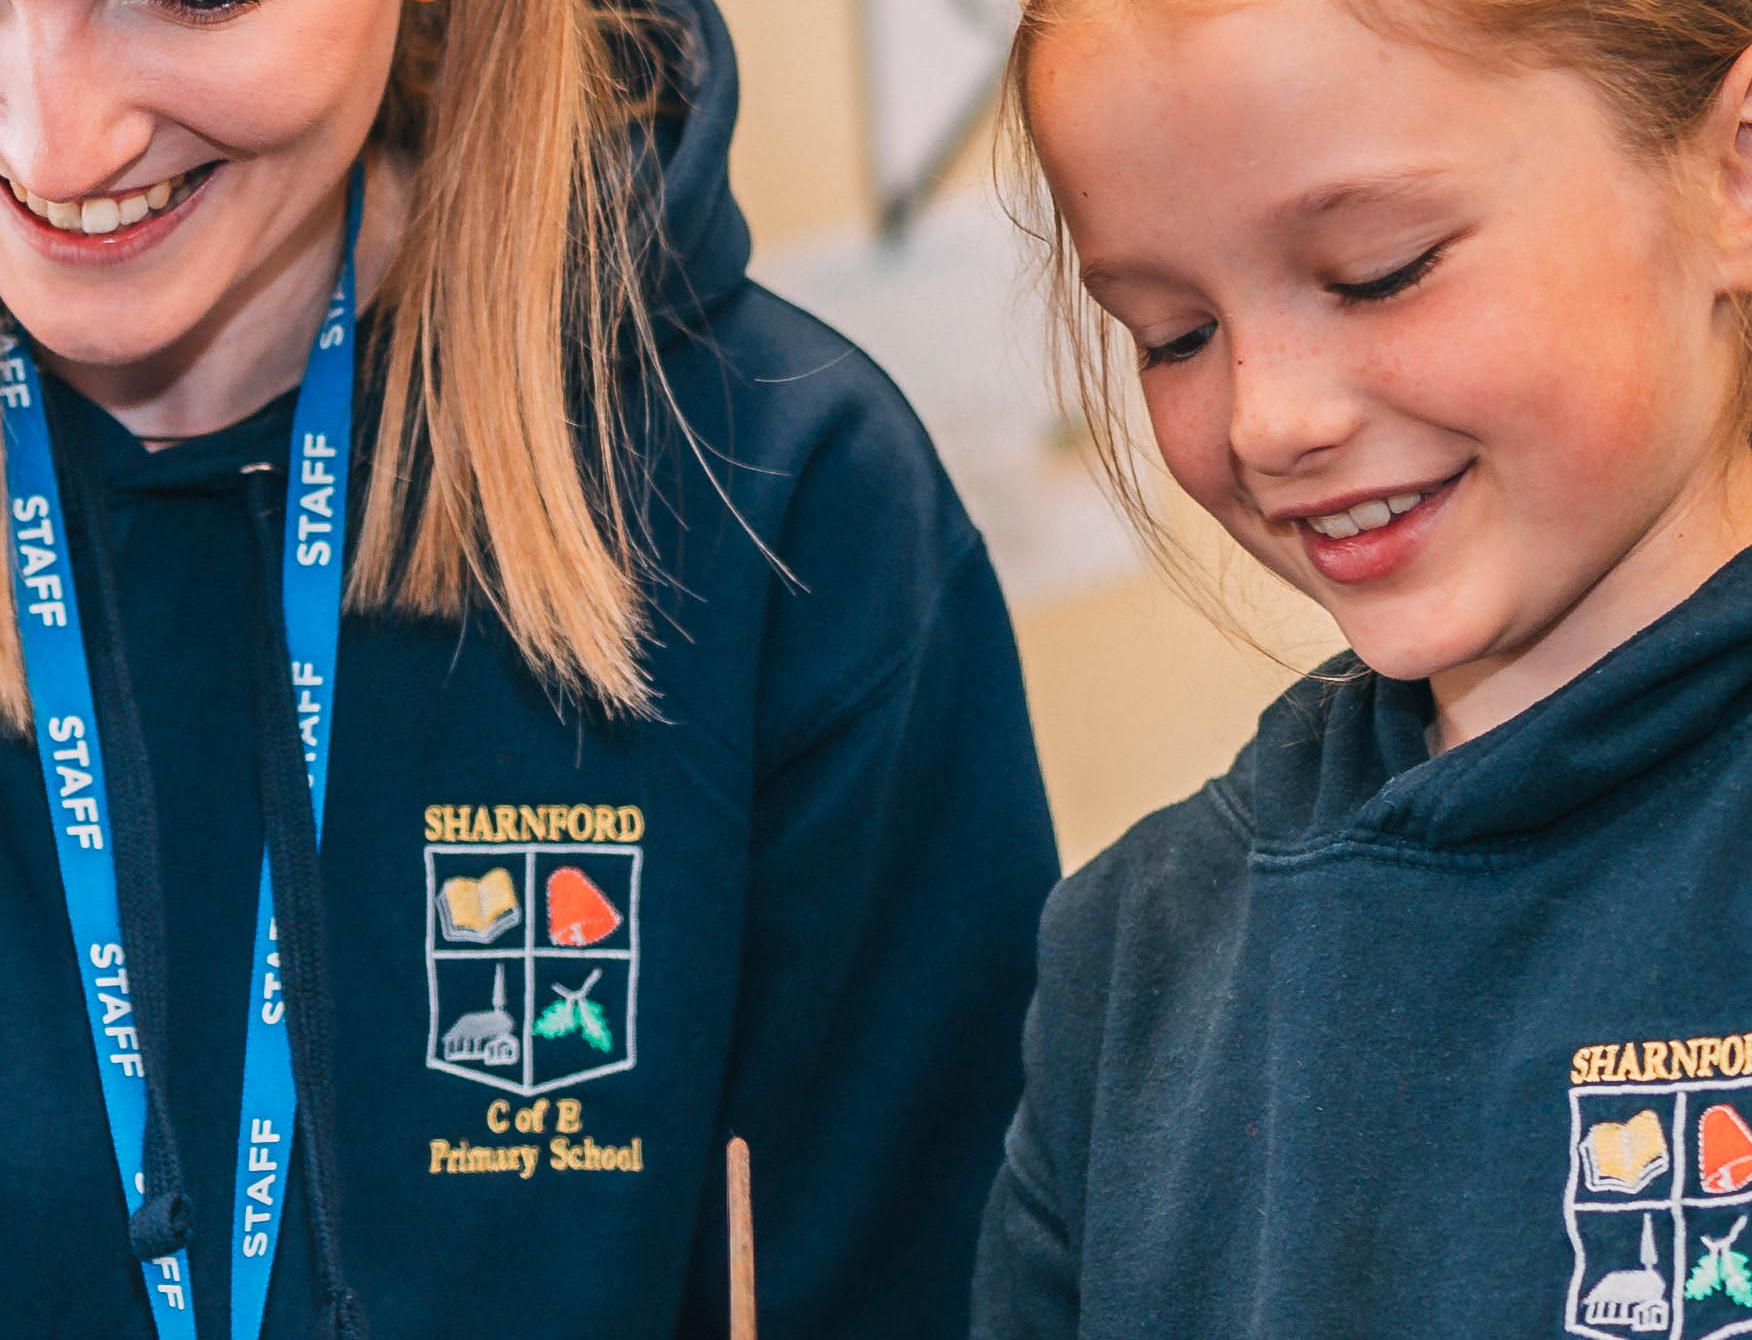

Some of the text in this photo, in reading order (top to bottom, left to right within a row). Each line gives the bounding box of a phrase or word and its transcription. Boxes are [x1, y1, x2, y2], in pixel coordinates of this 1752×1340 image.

[13, 494, 66, 628] STAFF
[296, 432, 337, 567] STAFF
[48, 715, 103, 851] STAFF
[291, 660, 324, 788] AFF
[424, 804, 645, 843] SHARNFORD
[89, 942, 145, 1078] STAFF
[261, 916, 284, 1026] STA
[428, 1136, 644, 1179] Primary School
[487, 1098, 582, 1134] C of E
[242, 1117, 280, 1259] STAFF
